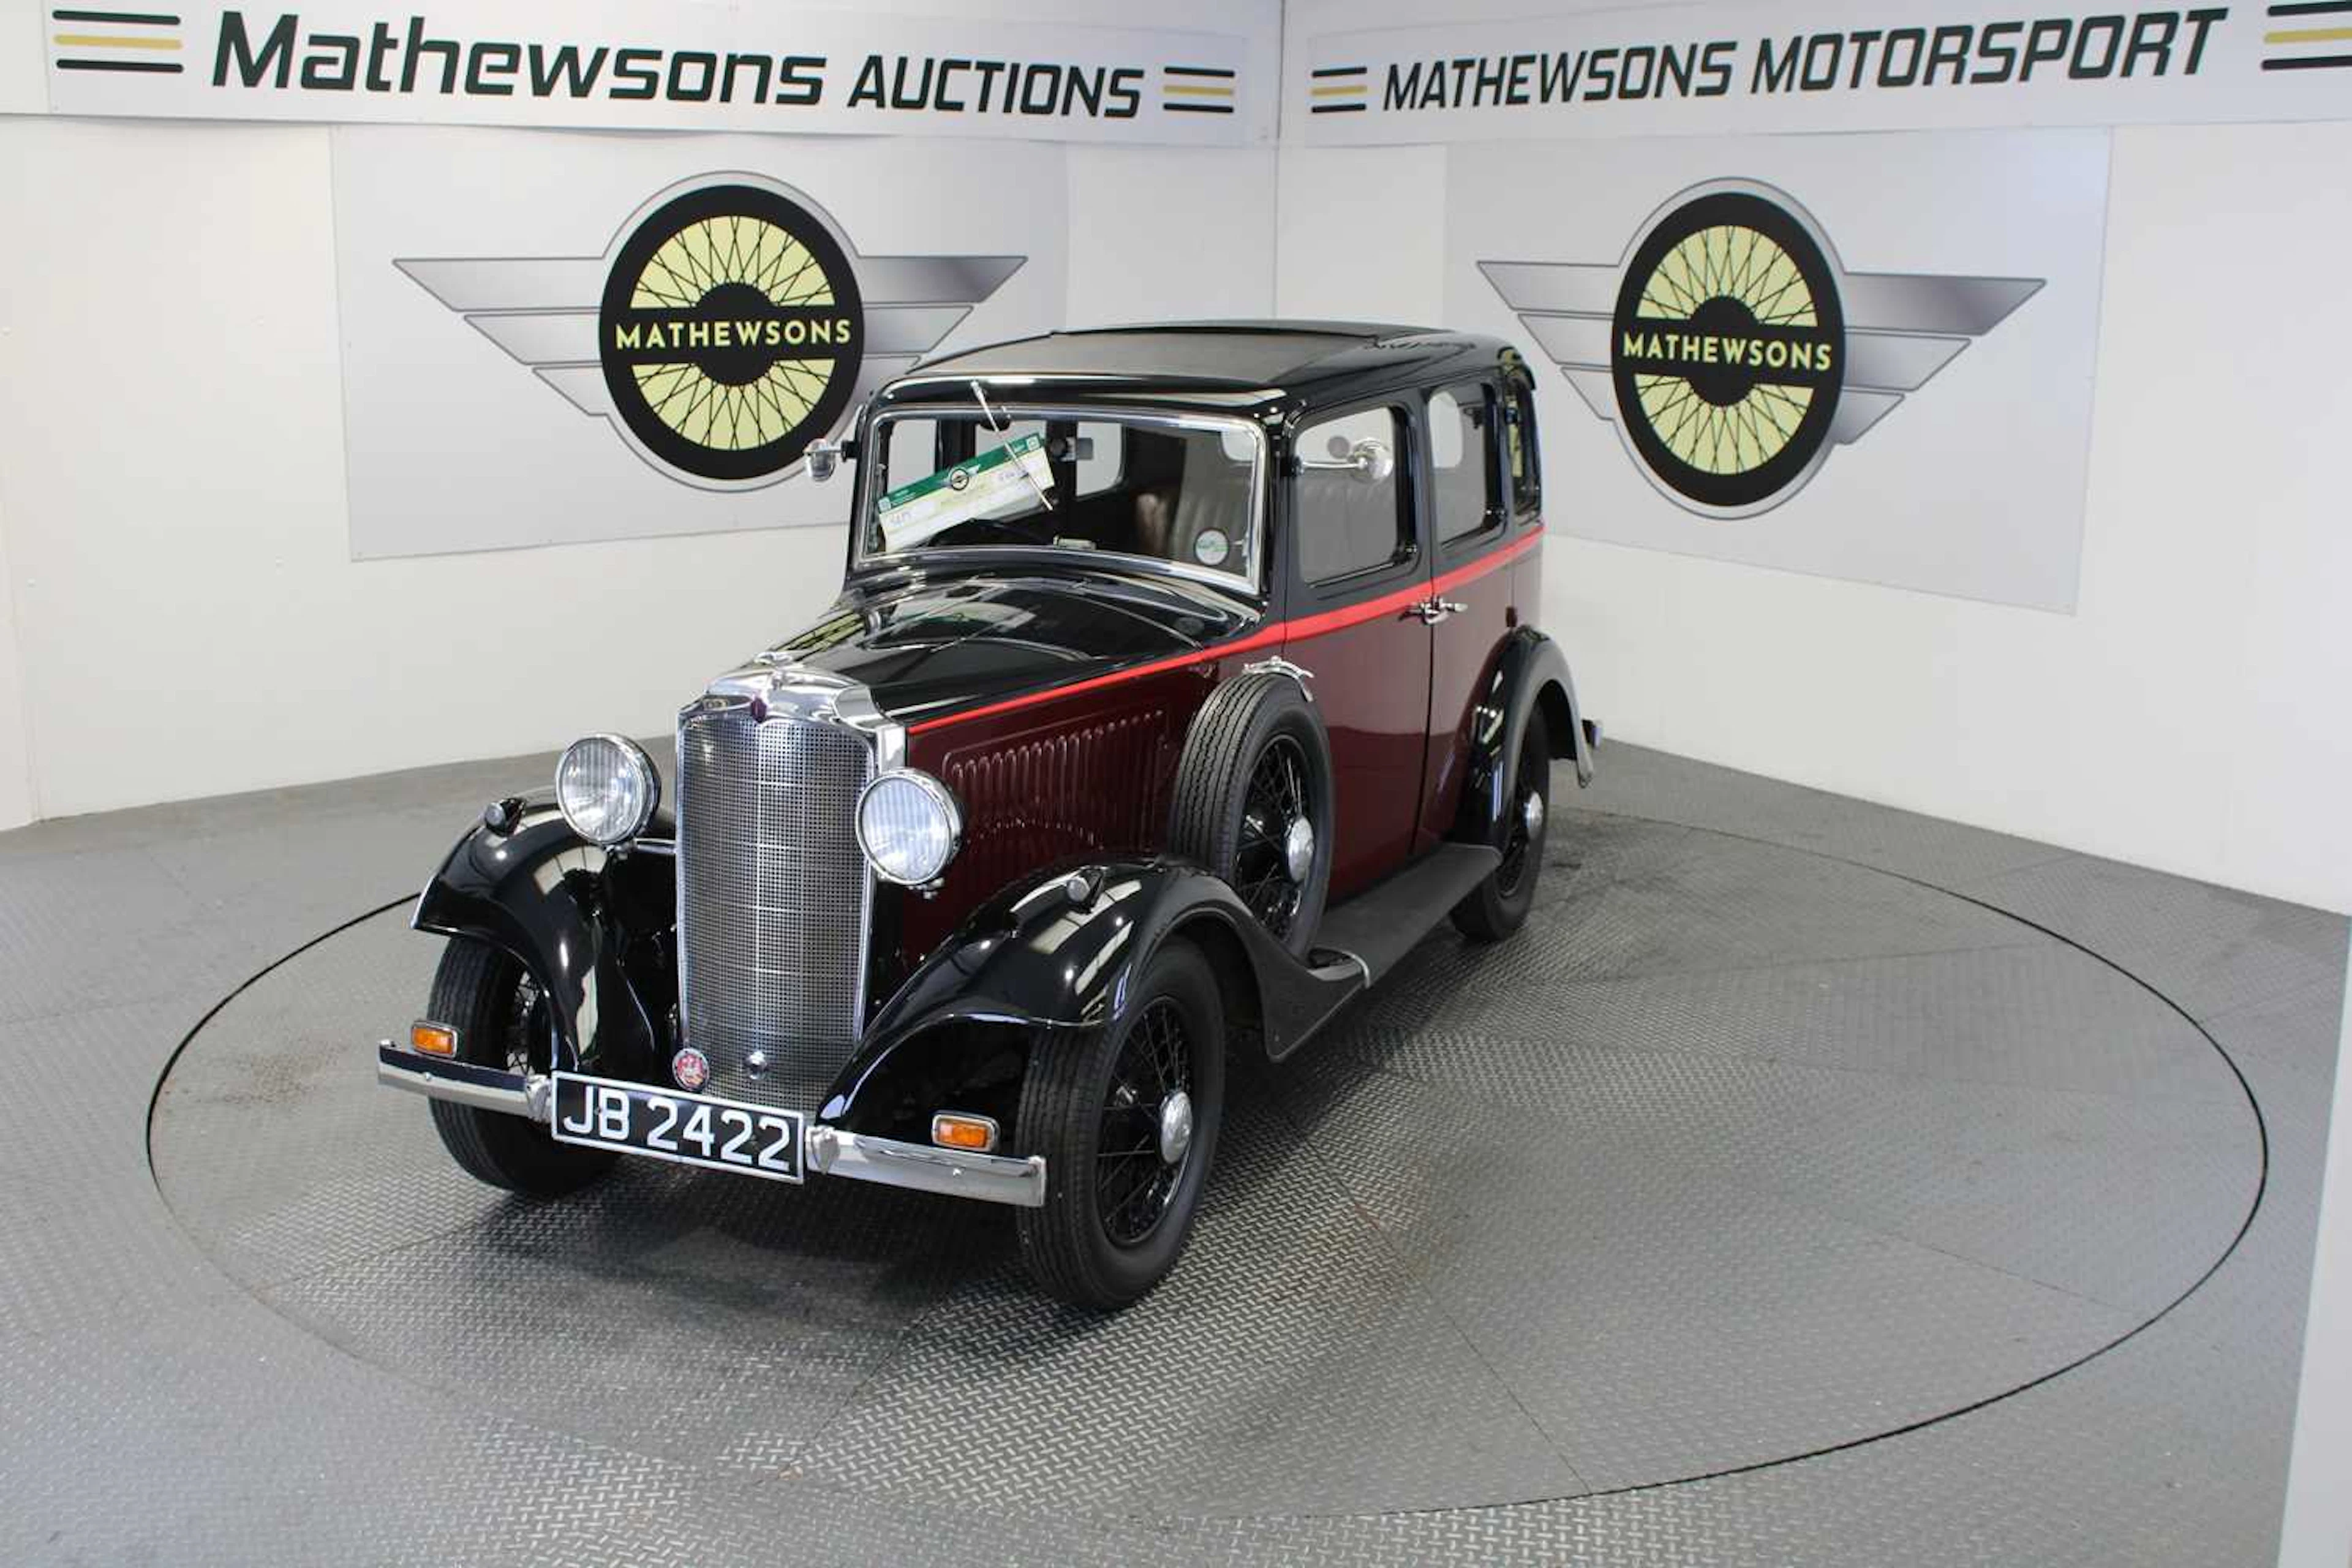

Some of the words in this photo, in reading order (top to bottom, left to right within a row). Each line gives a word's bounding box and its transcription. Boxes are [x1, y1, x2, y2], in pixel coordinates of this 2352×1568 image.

[212, 10, 827, 105] Mathewsons
[847, 55, 1144, 118] AUCTIONS
[1382, 40, 1738, 111] MATHEWSONS
[1750, 7, 2229, 94] MOTORSPORT
[615, 318, 851, 350] MATHEWSONS
[1623, 331, 1832, 371] MATHEWSONS
[563, 1084, 630, 1140] JB
[646, 1099, 791, 1172] 2422
